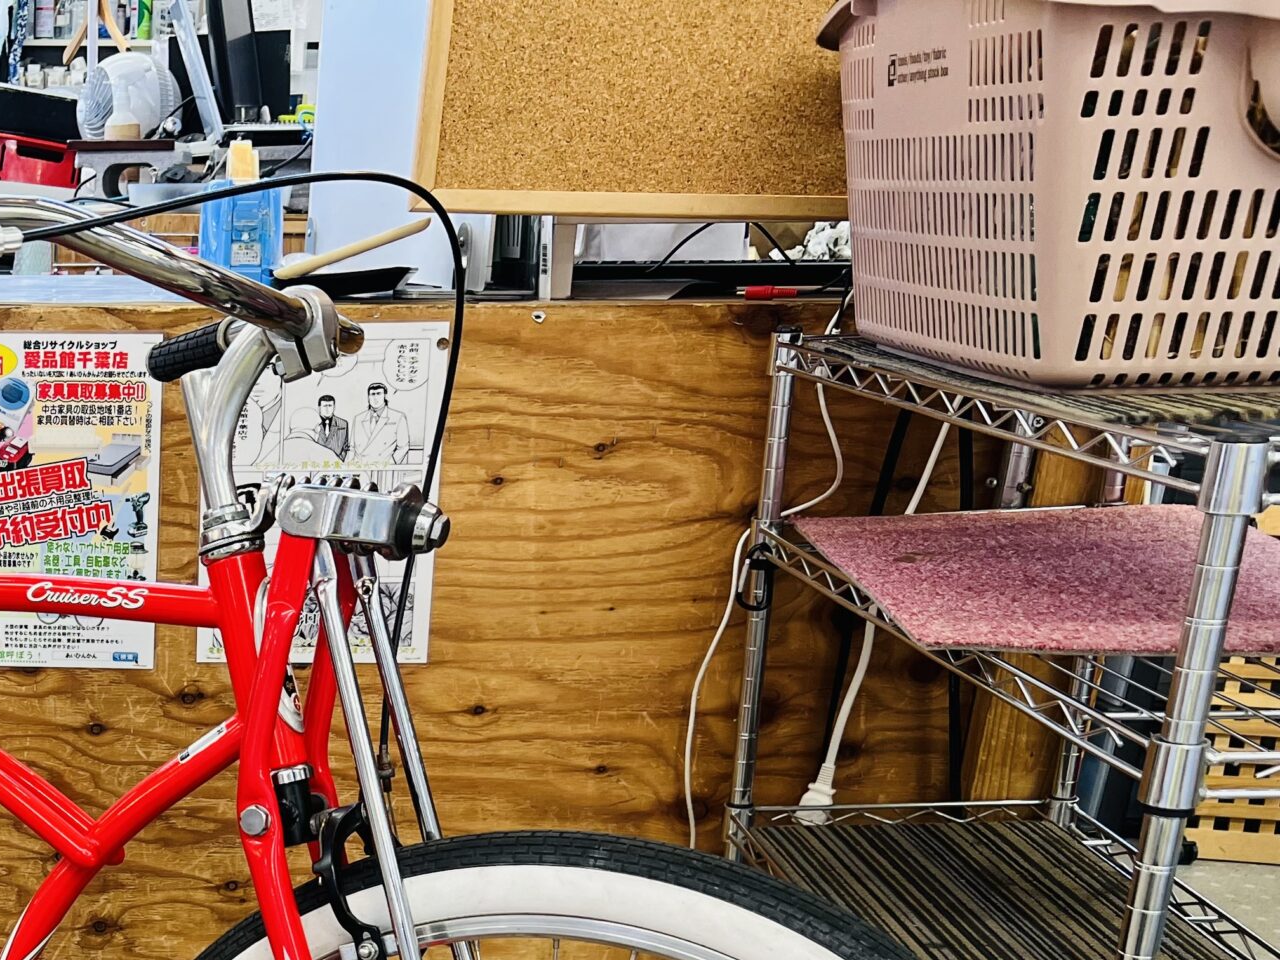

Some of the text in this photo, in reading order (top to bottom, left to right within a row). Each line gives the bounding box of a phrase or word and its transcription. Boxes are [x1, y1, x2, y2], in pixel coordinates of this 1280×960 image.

[23, 340, 118, 350] 総合リサイクルショップ
[24, 351, 128, 369] 愛品館千葉店
[26, 581, 149, 609] Cruiser SS
